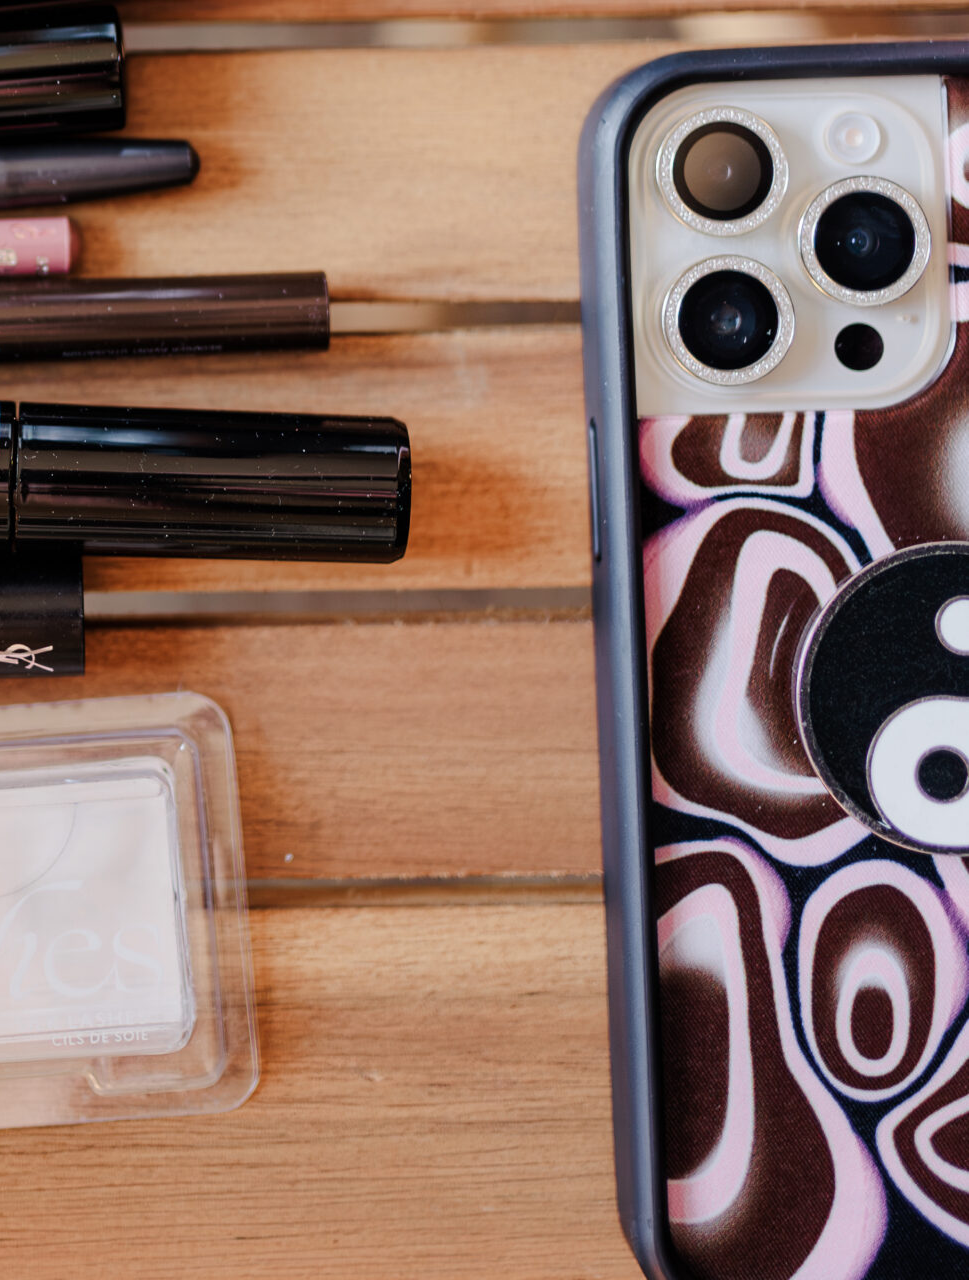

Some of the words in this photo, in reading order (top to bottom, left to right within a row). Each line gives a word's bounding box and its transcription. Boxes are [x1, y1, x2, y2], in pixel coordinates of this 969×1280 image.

[51, 1032, 86, 1048] CILS
[90, 1030, 110, 1045] DE
[115, 1028, 150, 1044] SOIE
